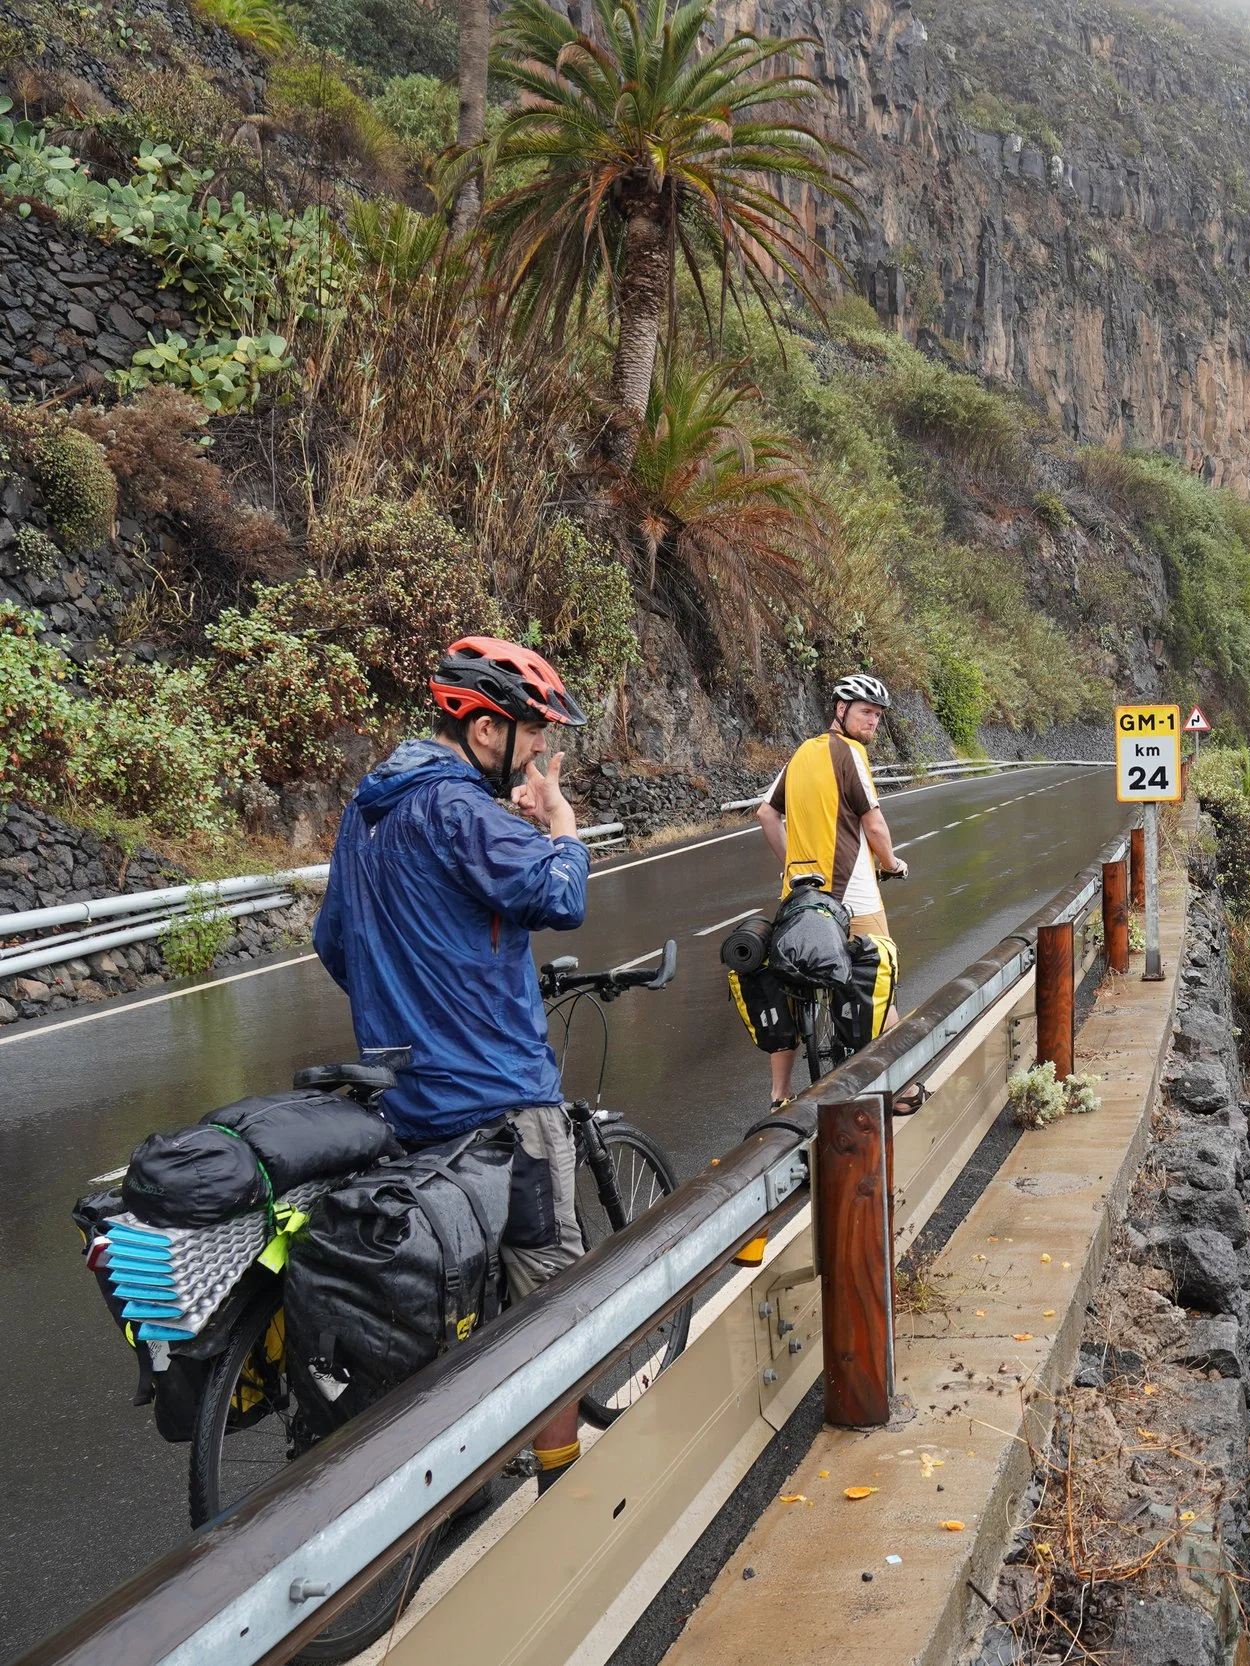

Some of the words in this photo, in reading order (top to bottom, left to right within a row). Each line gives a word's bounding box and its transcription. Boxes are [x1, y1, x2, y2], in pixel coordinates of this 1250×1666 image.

[1120, 714, 1174, 731] GM-1
[1135, 744, 1160, 756] km
[1128, 766, 1169, 790] 24
